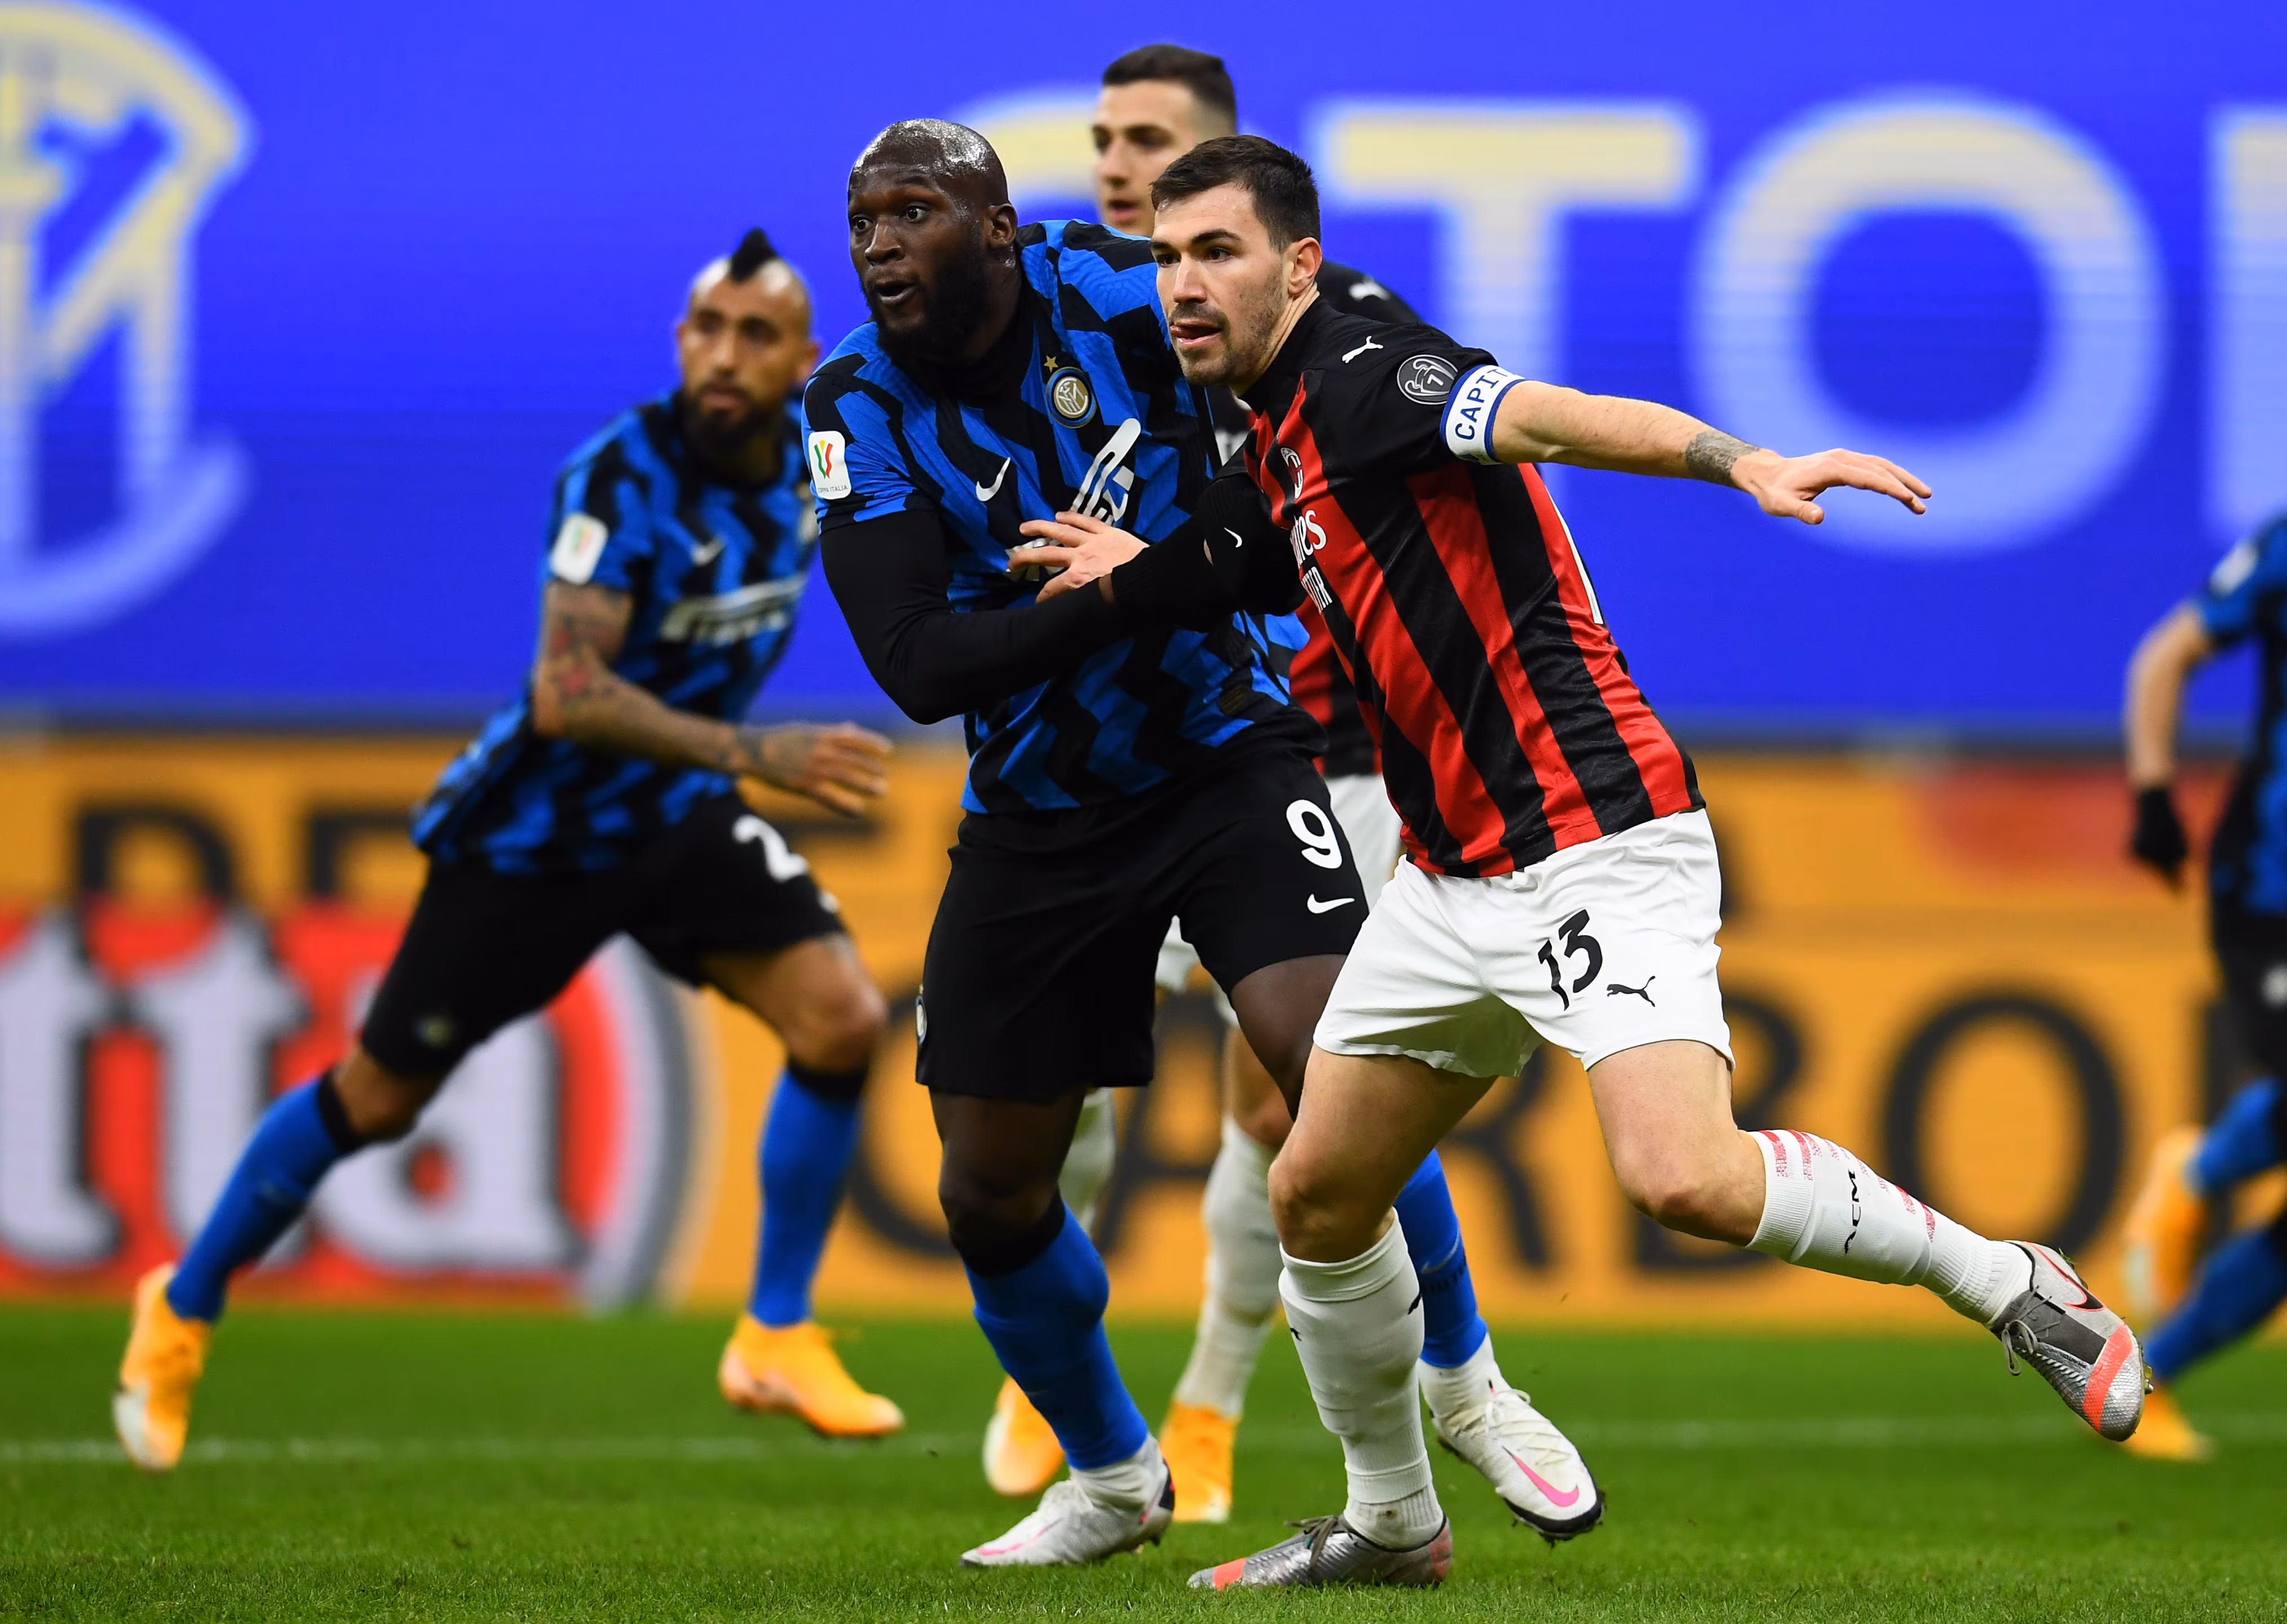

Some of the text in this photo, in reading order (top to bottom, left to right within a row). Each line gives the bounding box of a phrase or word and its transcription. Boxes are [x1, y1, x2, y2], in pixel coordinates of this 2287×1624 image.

[1427, 374, 1443, 386] 7
[1286, 799, 1342, 869] 9
[1538, 909, 1603, 1011] 13
